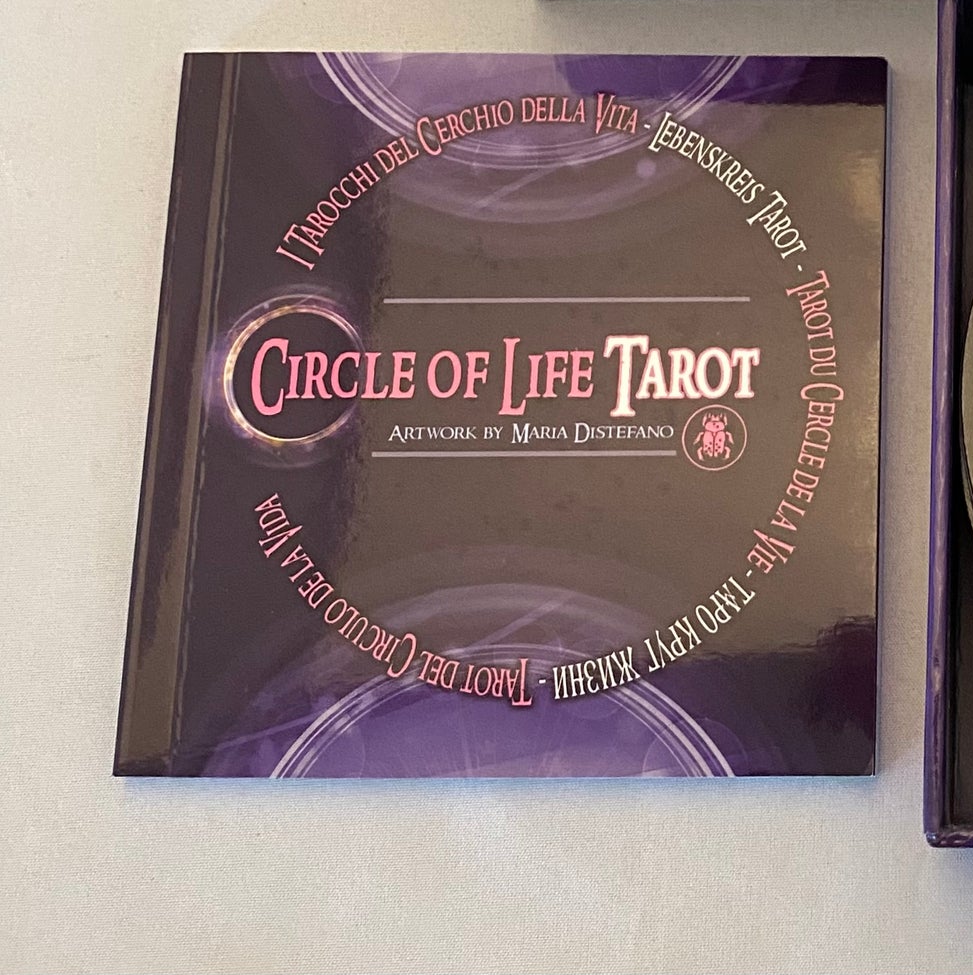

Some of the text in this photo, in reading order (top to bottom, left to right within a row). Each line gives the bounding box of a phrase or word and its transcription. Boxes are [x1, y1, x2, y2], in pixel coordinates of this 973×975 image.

[416, 100, 514, 156] CERCHIO
[521, 96, 585, 124] DELLA
[595, 92, 639, 135] VITA
[373, 135, 419, 174] DEL
[283, 162, 381, 256] TAROCCHI
[647, 111, 766, 205] LEBENSKREIS
[745, 190, 807, 260] TAROT
[276, 245, 315, 271] I
[785, 270, 830, 341] TAROT
[250, 334, 761, 419] CIRCLE OF LIFE TAROT
[809, 346, 837, 377] DU
[388, 422, 674, 444] ARTWORK BY MARIA DISTEFANO
[797, 382, 844, 470] CERCLE
[786, 468, 820, 504] DE
[770, 499, 806, 532] LA
[747, 528, 797, 574] VIE
[254, 492, 532, 706] TAROT DEL CIRCULO DE LA VIDA
[695, 576, 756, 634] ТАРО
[643, 615, 702, 673] КРУГ
[552, 646, 641, 700] ЖИЗНИ
